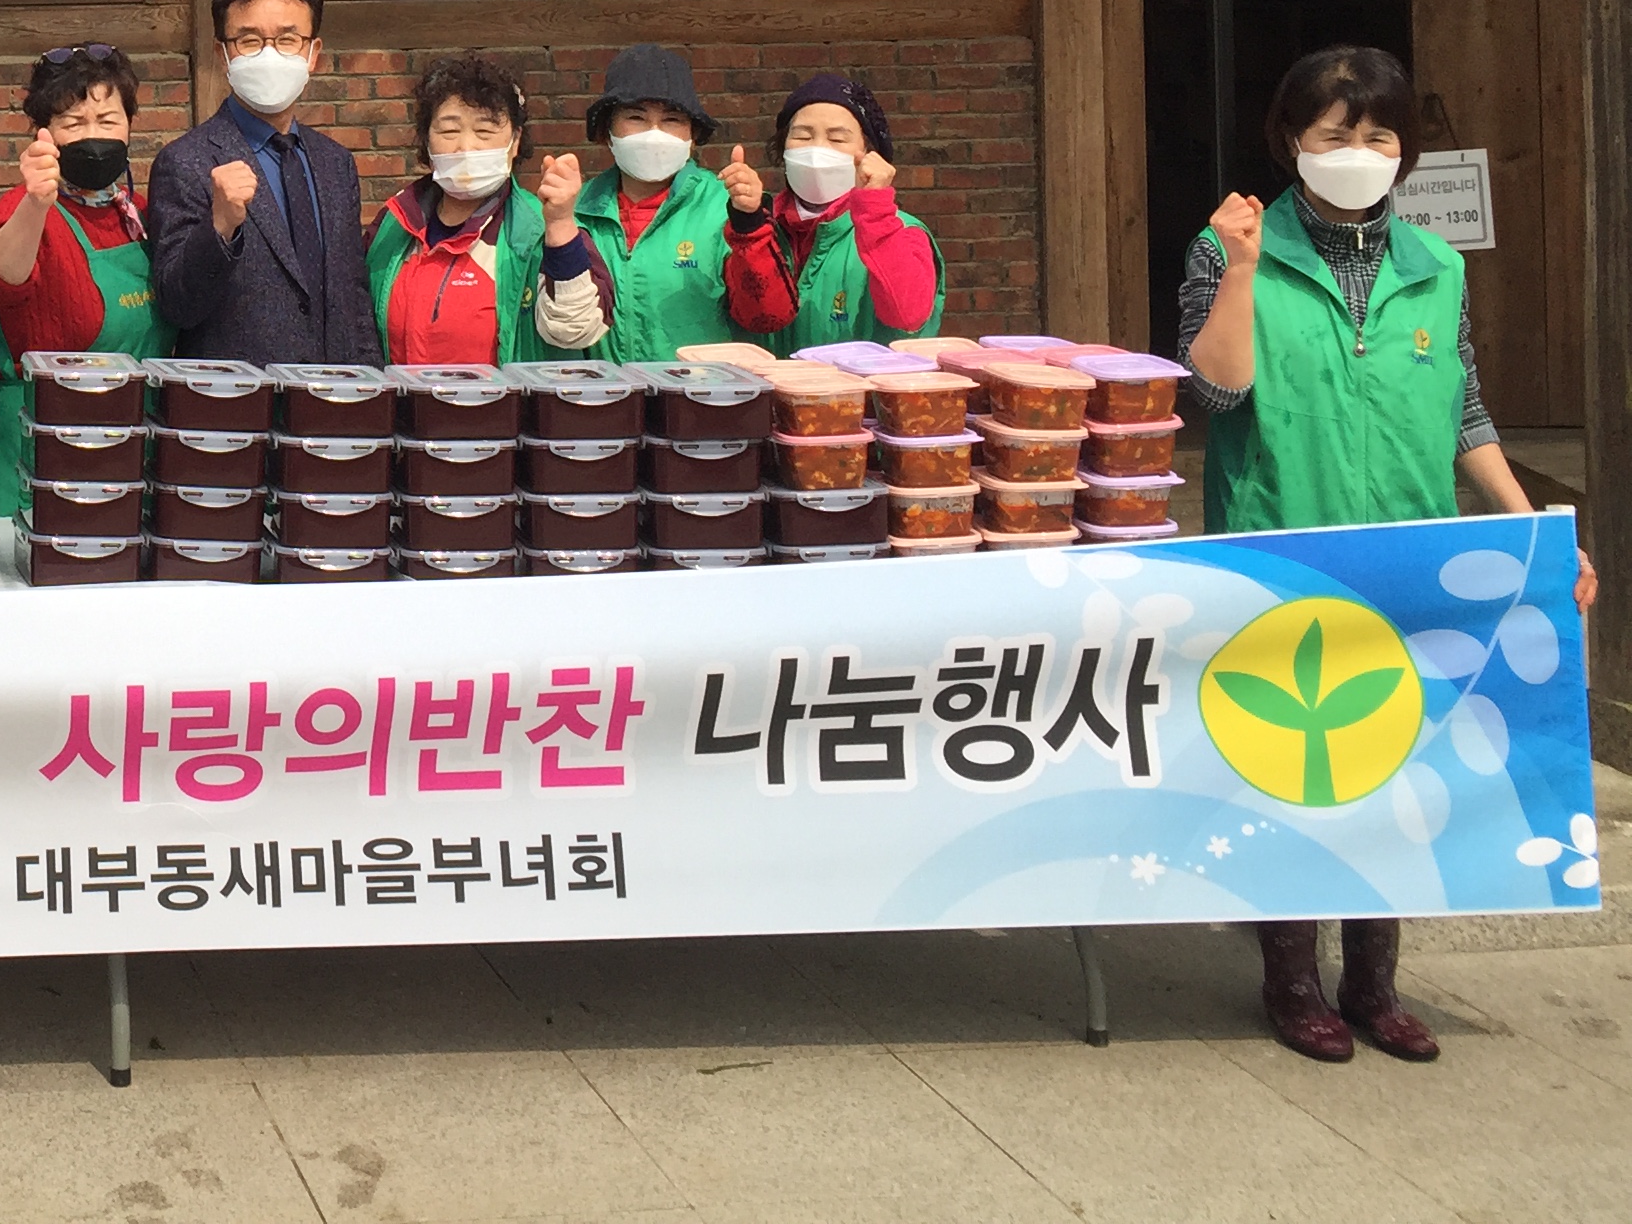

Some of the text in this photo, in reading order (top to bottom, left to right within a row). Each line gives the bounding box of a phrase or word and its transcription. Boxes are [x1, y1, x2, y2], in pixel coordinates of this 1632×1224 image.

[1446, 209, 1479, 224] 13:00
[39, 666, 644, 802] 사랑의반찬
[694, 637, 1160, 785] 나눔행사
[15, 832, 627, 914] 대부동새마을부녀회
